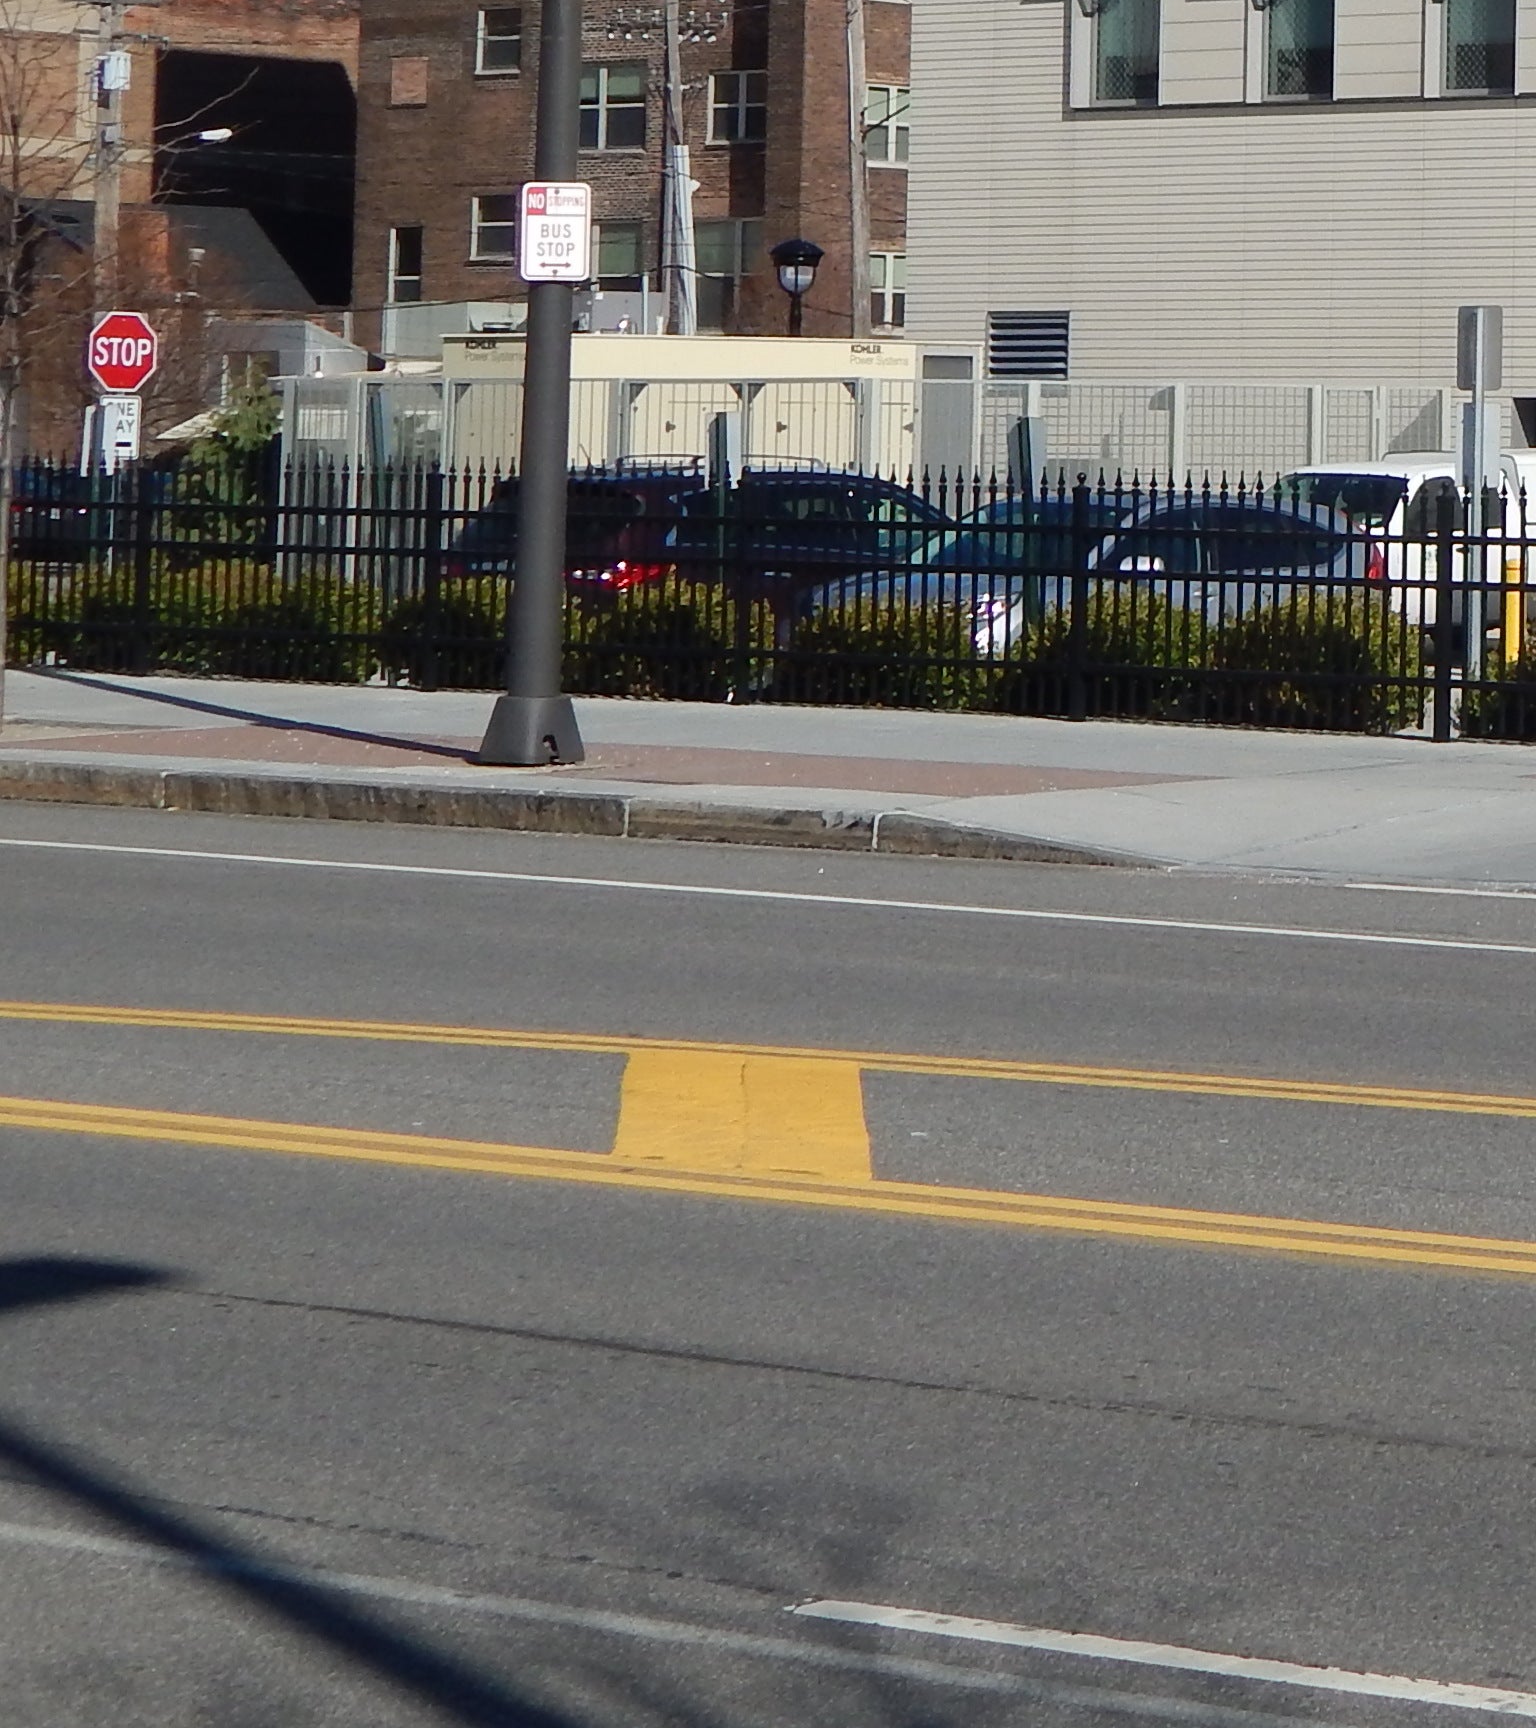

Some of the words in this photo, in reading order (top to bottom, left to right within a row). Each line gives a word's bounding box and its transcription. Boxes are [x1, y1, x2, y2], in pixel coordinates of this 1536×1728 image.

[528, 193, 545, 210] NO
[548, 196, 585, 207] STOPPING
[540, 223, 572, 238] BUS
[536, 242, 575, 257] STOP
[94, 336, 151, 367] STOP
[851, 344, 882, 354] KOHLER
